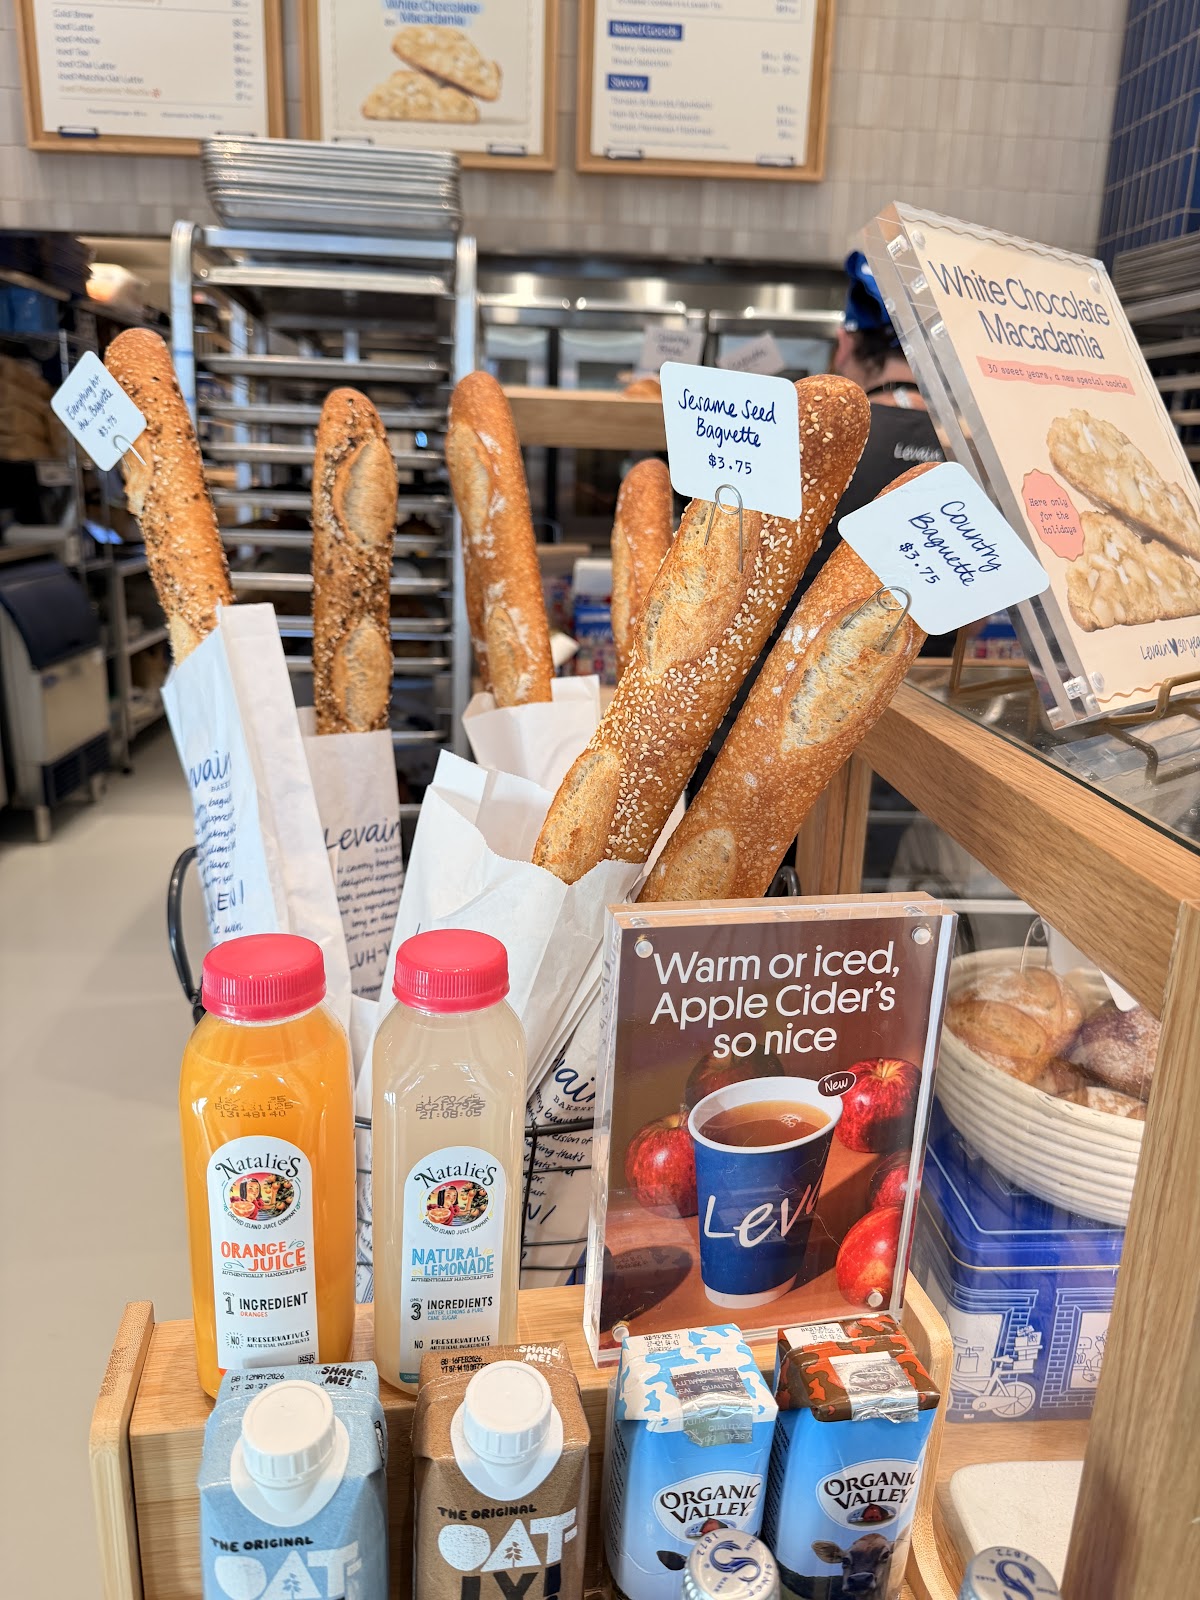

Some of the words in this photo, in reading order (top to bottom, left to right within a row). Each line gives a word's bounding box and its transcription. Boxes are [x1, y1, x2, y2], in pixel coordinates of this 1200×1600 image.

[927, 260, 1007, 306] White
[1005, 278, 1111, 326] Chocolate
[978, 310, 1105, 360] Macadamia
[987, 363, 998, 373] 30
[1000, 367, 1024, 377] sweet
[1061, 374, 1074, 382] new
[1076, 375, 1103, 387] special
[1105, 379, 1128, 389] cookie
[678, 388, 738, 418] Sesame
[741, 399, 777, 424] Seed
[696, 416, 761, 448] Baguette
[708, 453, 752, 475] $3.75
[1029, 498, 1048, 507] Here
[1050, 498, 1068, 509] only
[1040, 512, 1053, 523] for
[1056, 511, 1069, 520] the
[940, 501, 1002, 573] Country
[1042, 525, 1077, 535] holidays
[908, 512, 975, 587] Baguette
[899, 542, 940, 584] $3.75
[653, 950, 761, 985] Warm
[769, 951, 808, 979] or
[814, 941, 900, 978] iced,
[650, 986, 768, 1030] Apple
[776, 980, 896, 1017] Cider's
[713, 1031, 756, 1059] so
[764, 1022, 837, 1056] nice
[824, 1077, 849, 1093] New
[220, 1110, 287, 1118] 13:48:40
[419, 1108, 482, 1119] 21:08:05
[582, 1136, 594, 1145] of
[227, 1212, 244, 1226] ORCHID
[244, 1222, 261, 1230] ISLAND
[278, 1208, 297, 1226] COMPANY
[422, 1218, 439, 1232] ORCHID
[439, 1227, 456, 1235] ISLAND
[470, 1216, 490, 1231] COMPANY
[220, 1241, 287, 1258] ORANGE
[248, 1247, 306, 1272] JUICE
[411, 1247, 481, 1266] NATURAL
[222, 1270, 263, 1278] AUTHENTICALLY
[265, 1266, 307, 1277] HANDCRAFTED
[424, 1254, 494, 1276] LEMONADE
[225, 1296, 235, 1315] 1
[239, 1292, 308, 1311] INGREDIENT
[411, 1302, 422, 1320] 3
[427, 1296, 493, 1310] INGREDIENTS
[231, 1336, 240, 1345] NO
[247, 1330, 310, 1343] PRESERVATIVES
[277, 1337, 310, 1347] INGREDIENTS
[414, 1340, 423, 1349] NO
[431, 1335, 490, 1345] PRESERVATIVES
[518, 1345, 559, 1356] SHAKE
[525, 1354, 551, 1364] ME!
[321, 1365, 364, 1379] SHAKE
[325, 1375, 353, 1387] ME!
[701, 1383, 734, 1391] QUALITY
[824, 1469, 918, 1496] ORGANIC
[660, 1482, 761, 1510] ORGANIC
[833, 1487, 911, 1510] VALLEY
[436, 1506, 467, 1521] THE
[471, 1503, 537, 1520] ORIGINAL
[670, 1501, 753, 1524] VALLEY
[210, 1537, 239, 1552] THE
[243, 1536, 314, 1551] ORIGINAL
[696, 1532, 719, 1556] 1872
